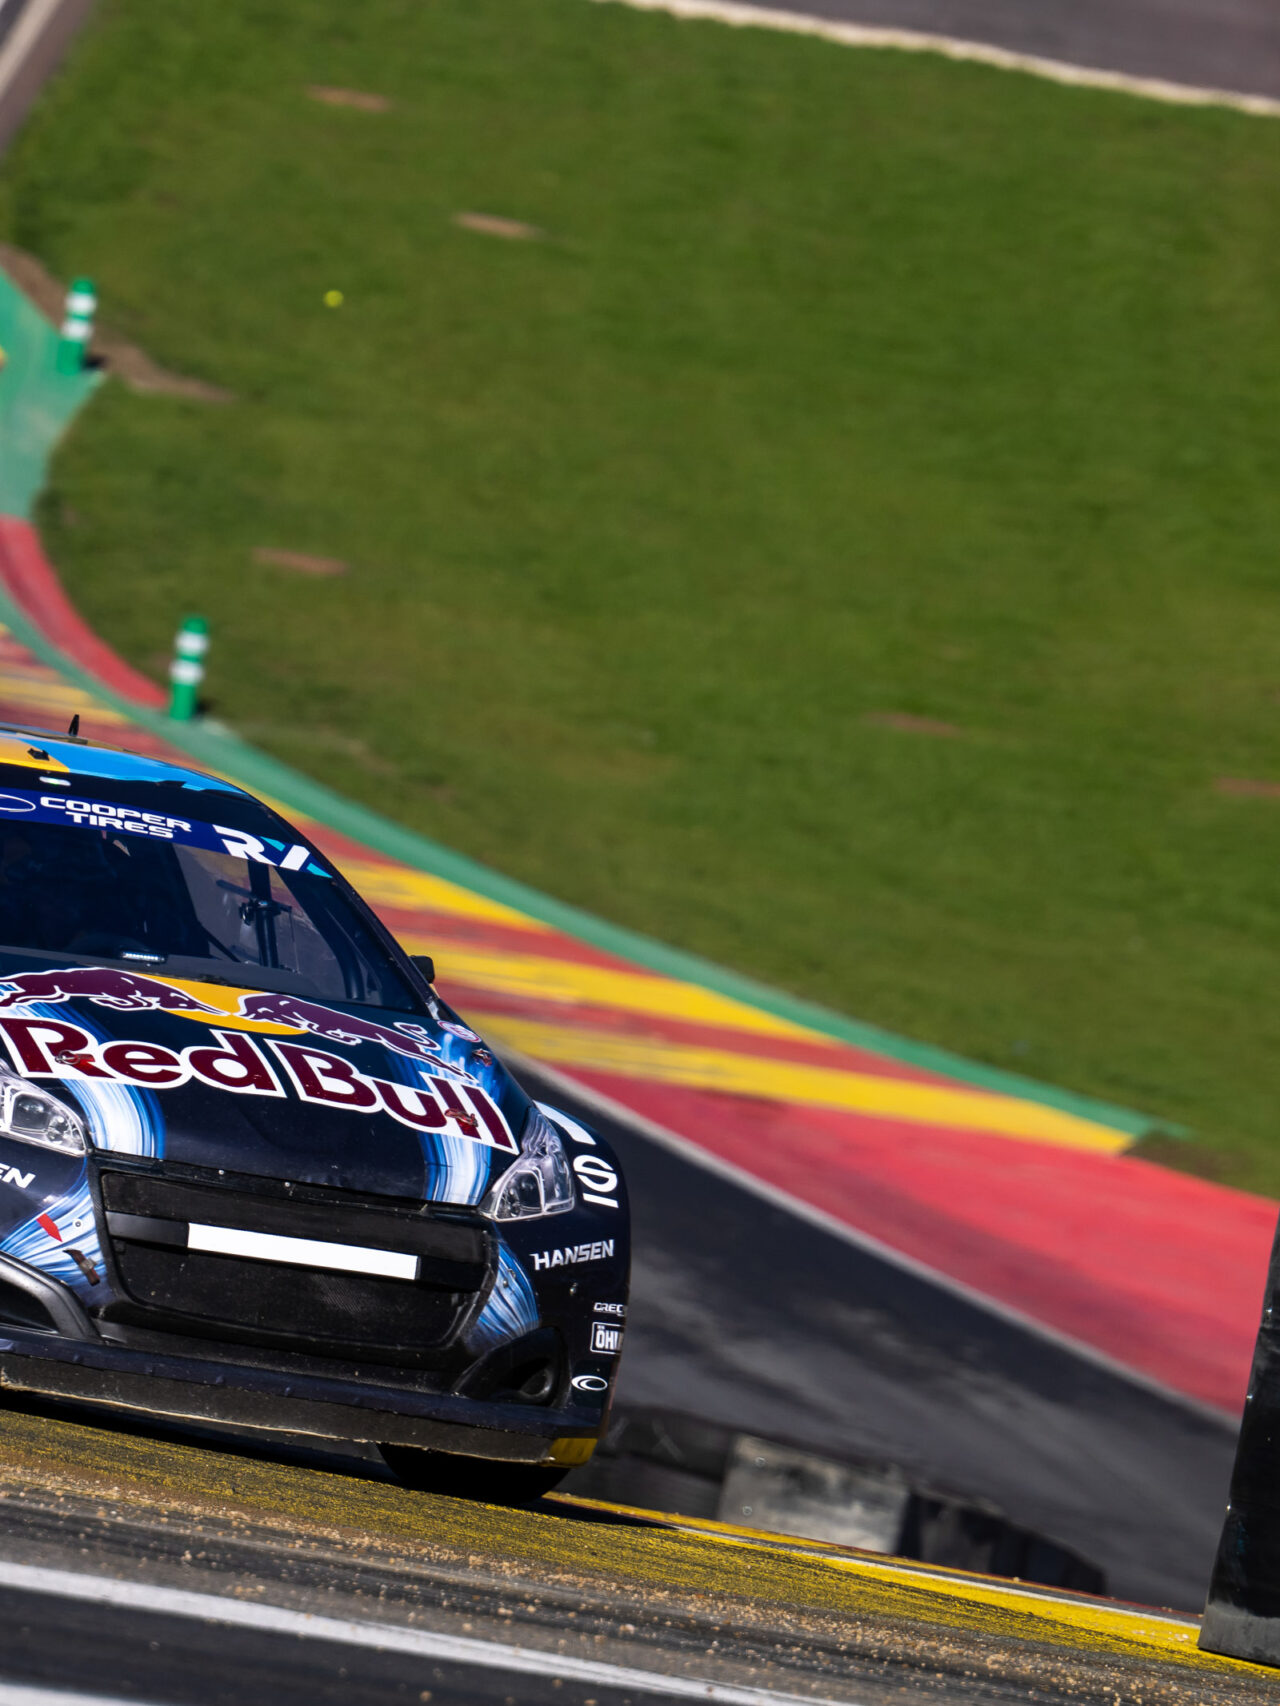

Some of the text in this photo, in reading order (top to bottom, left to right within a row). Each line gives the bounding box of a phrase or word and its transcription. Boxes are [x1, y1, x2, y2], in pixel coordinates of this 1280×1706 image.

[40, 796, 192, 832] COOPER
[65, 811, 175, 839] TIRES
[263, 1038, 520, 1155] Bull
[529, 1239, 615, 1271] HANSEN
